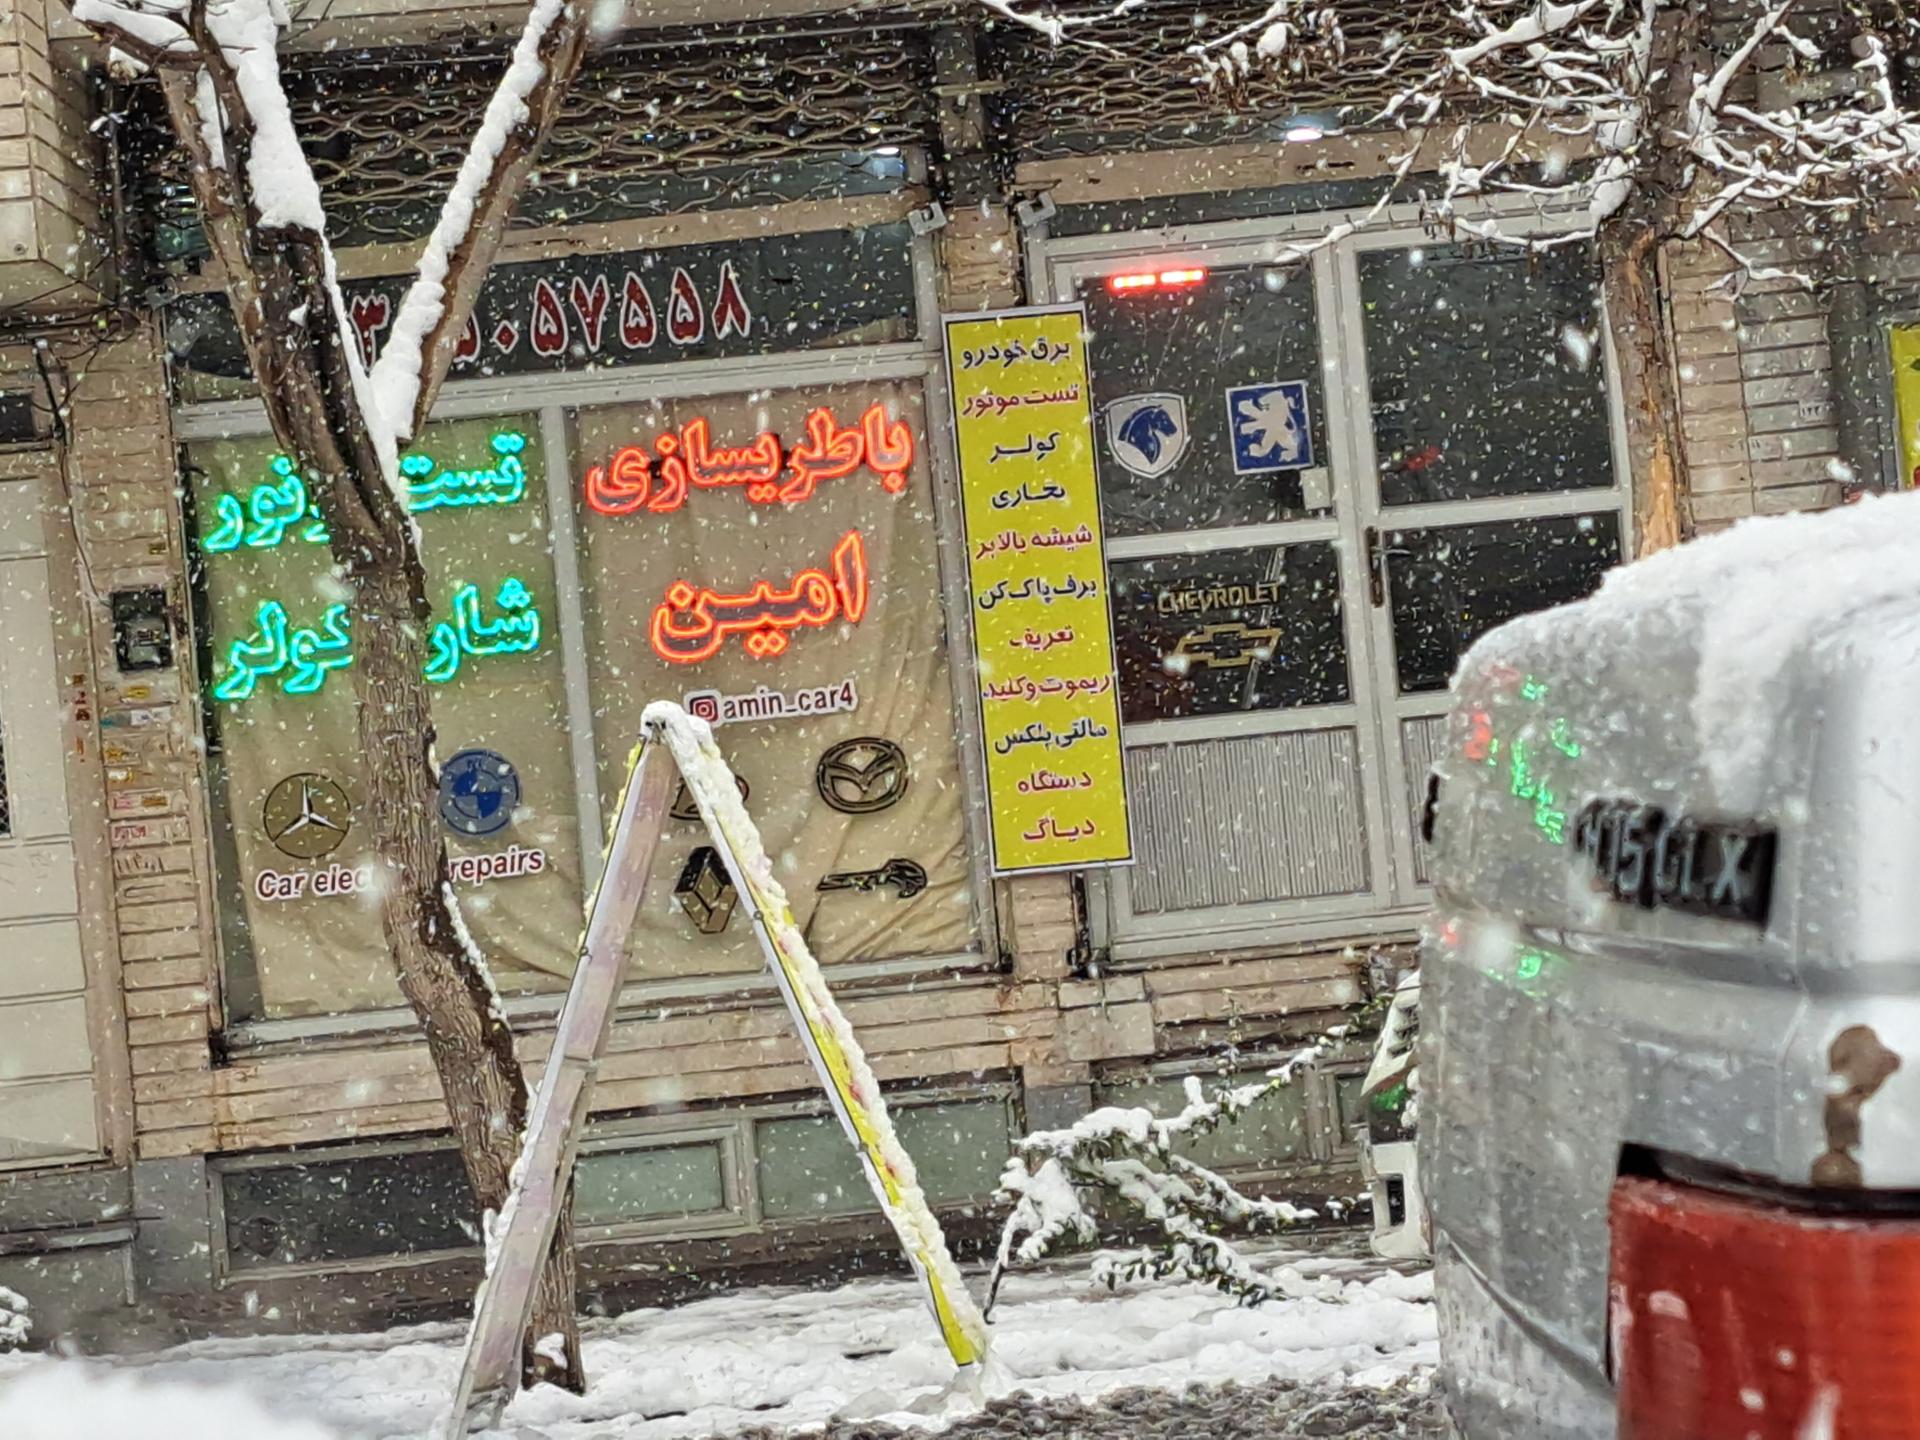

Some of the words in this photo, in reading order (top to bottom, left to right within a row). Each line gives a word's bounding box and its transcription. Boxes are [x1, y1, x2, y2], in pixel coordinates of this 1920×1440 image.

[963, 339, 1027, 369] خودرو
[1031, 337, 1070, 362] برق
[962, 390, 1020, 418] موتور
[1024, 384, 1079, 404] تست
[989, 432, 1061, 463] کولر
[402, 431, 526, 513] تست
[1031, 524, 1093, 551] شیشه
[651, 528, 867, 662] امین
[1052, 574, 1097, 599] برف
[1157, 582, 1280, 614] CHEVROLET
[215, 600, 355, 701] کولر
[723, 680, 854, 719] amin_car4
[1039, 674, 1111, 700] ریموت
[1017, 770, 1092, 793] دستگاه
[1022, 818, 1096, 843] دیاگ
[257, 870, 306, 899] Car
[450, 847, 543, 885] repairs
